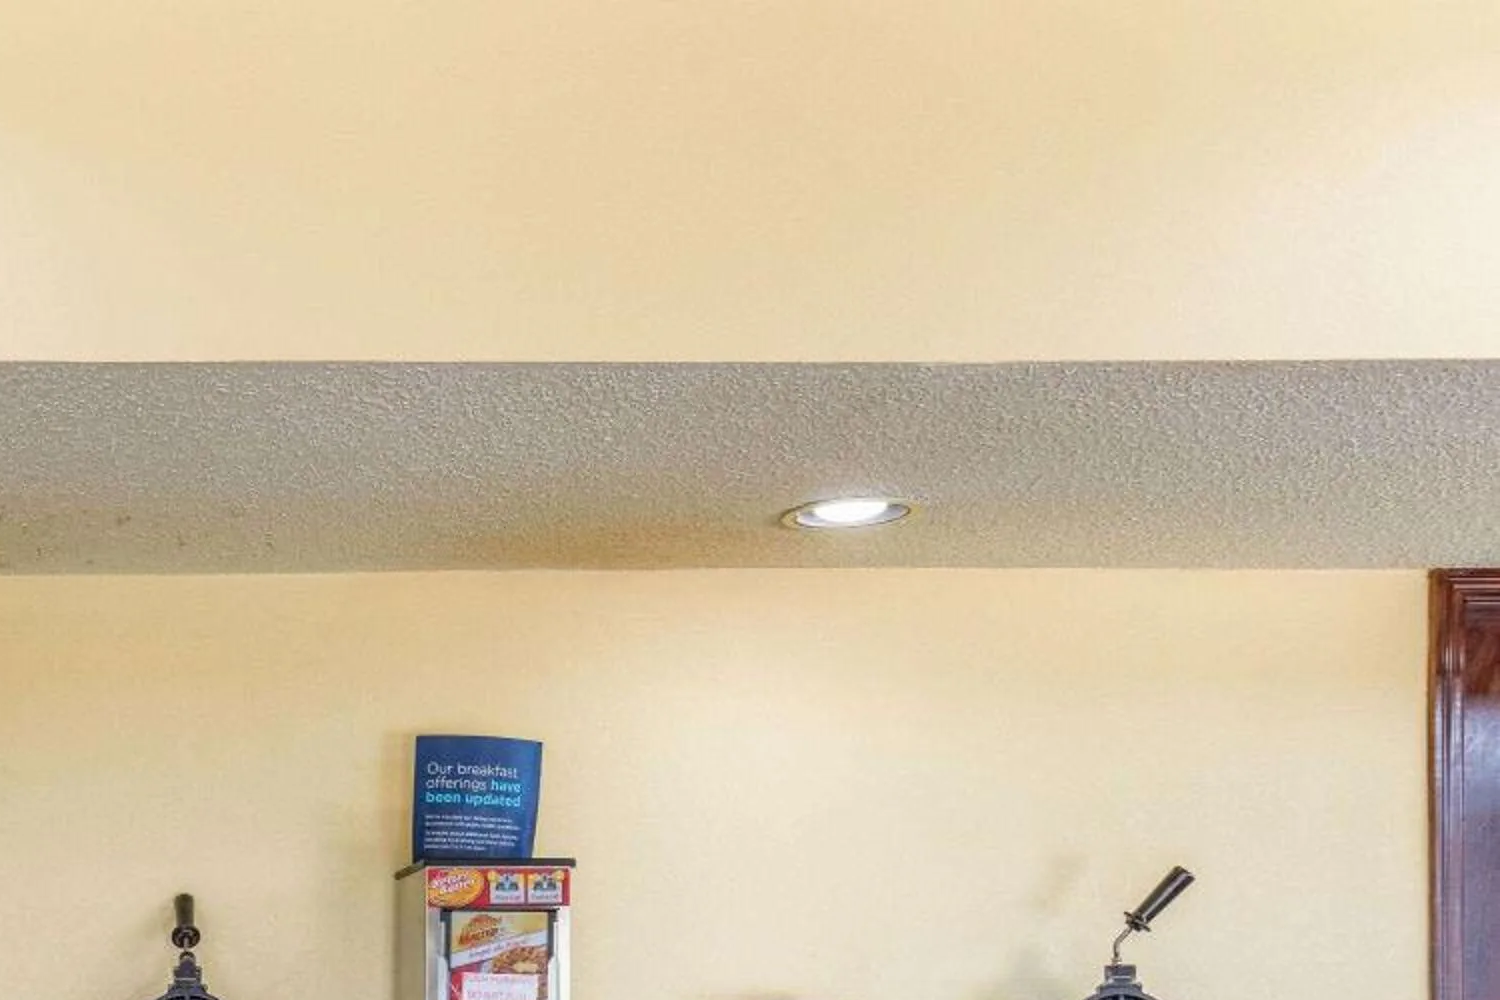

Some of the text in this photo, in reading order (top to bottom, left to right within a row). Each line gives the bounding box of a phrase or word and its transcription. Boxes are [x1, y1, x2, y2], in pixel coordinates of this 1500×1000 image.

[427, 761, 518, 779] Our breakfast
[425, 776, 522, 792] offerings have
[425, 792, 521, 807] been updated
